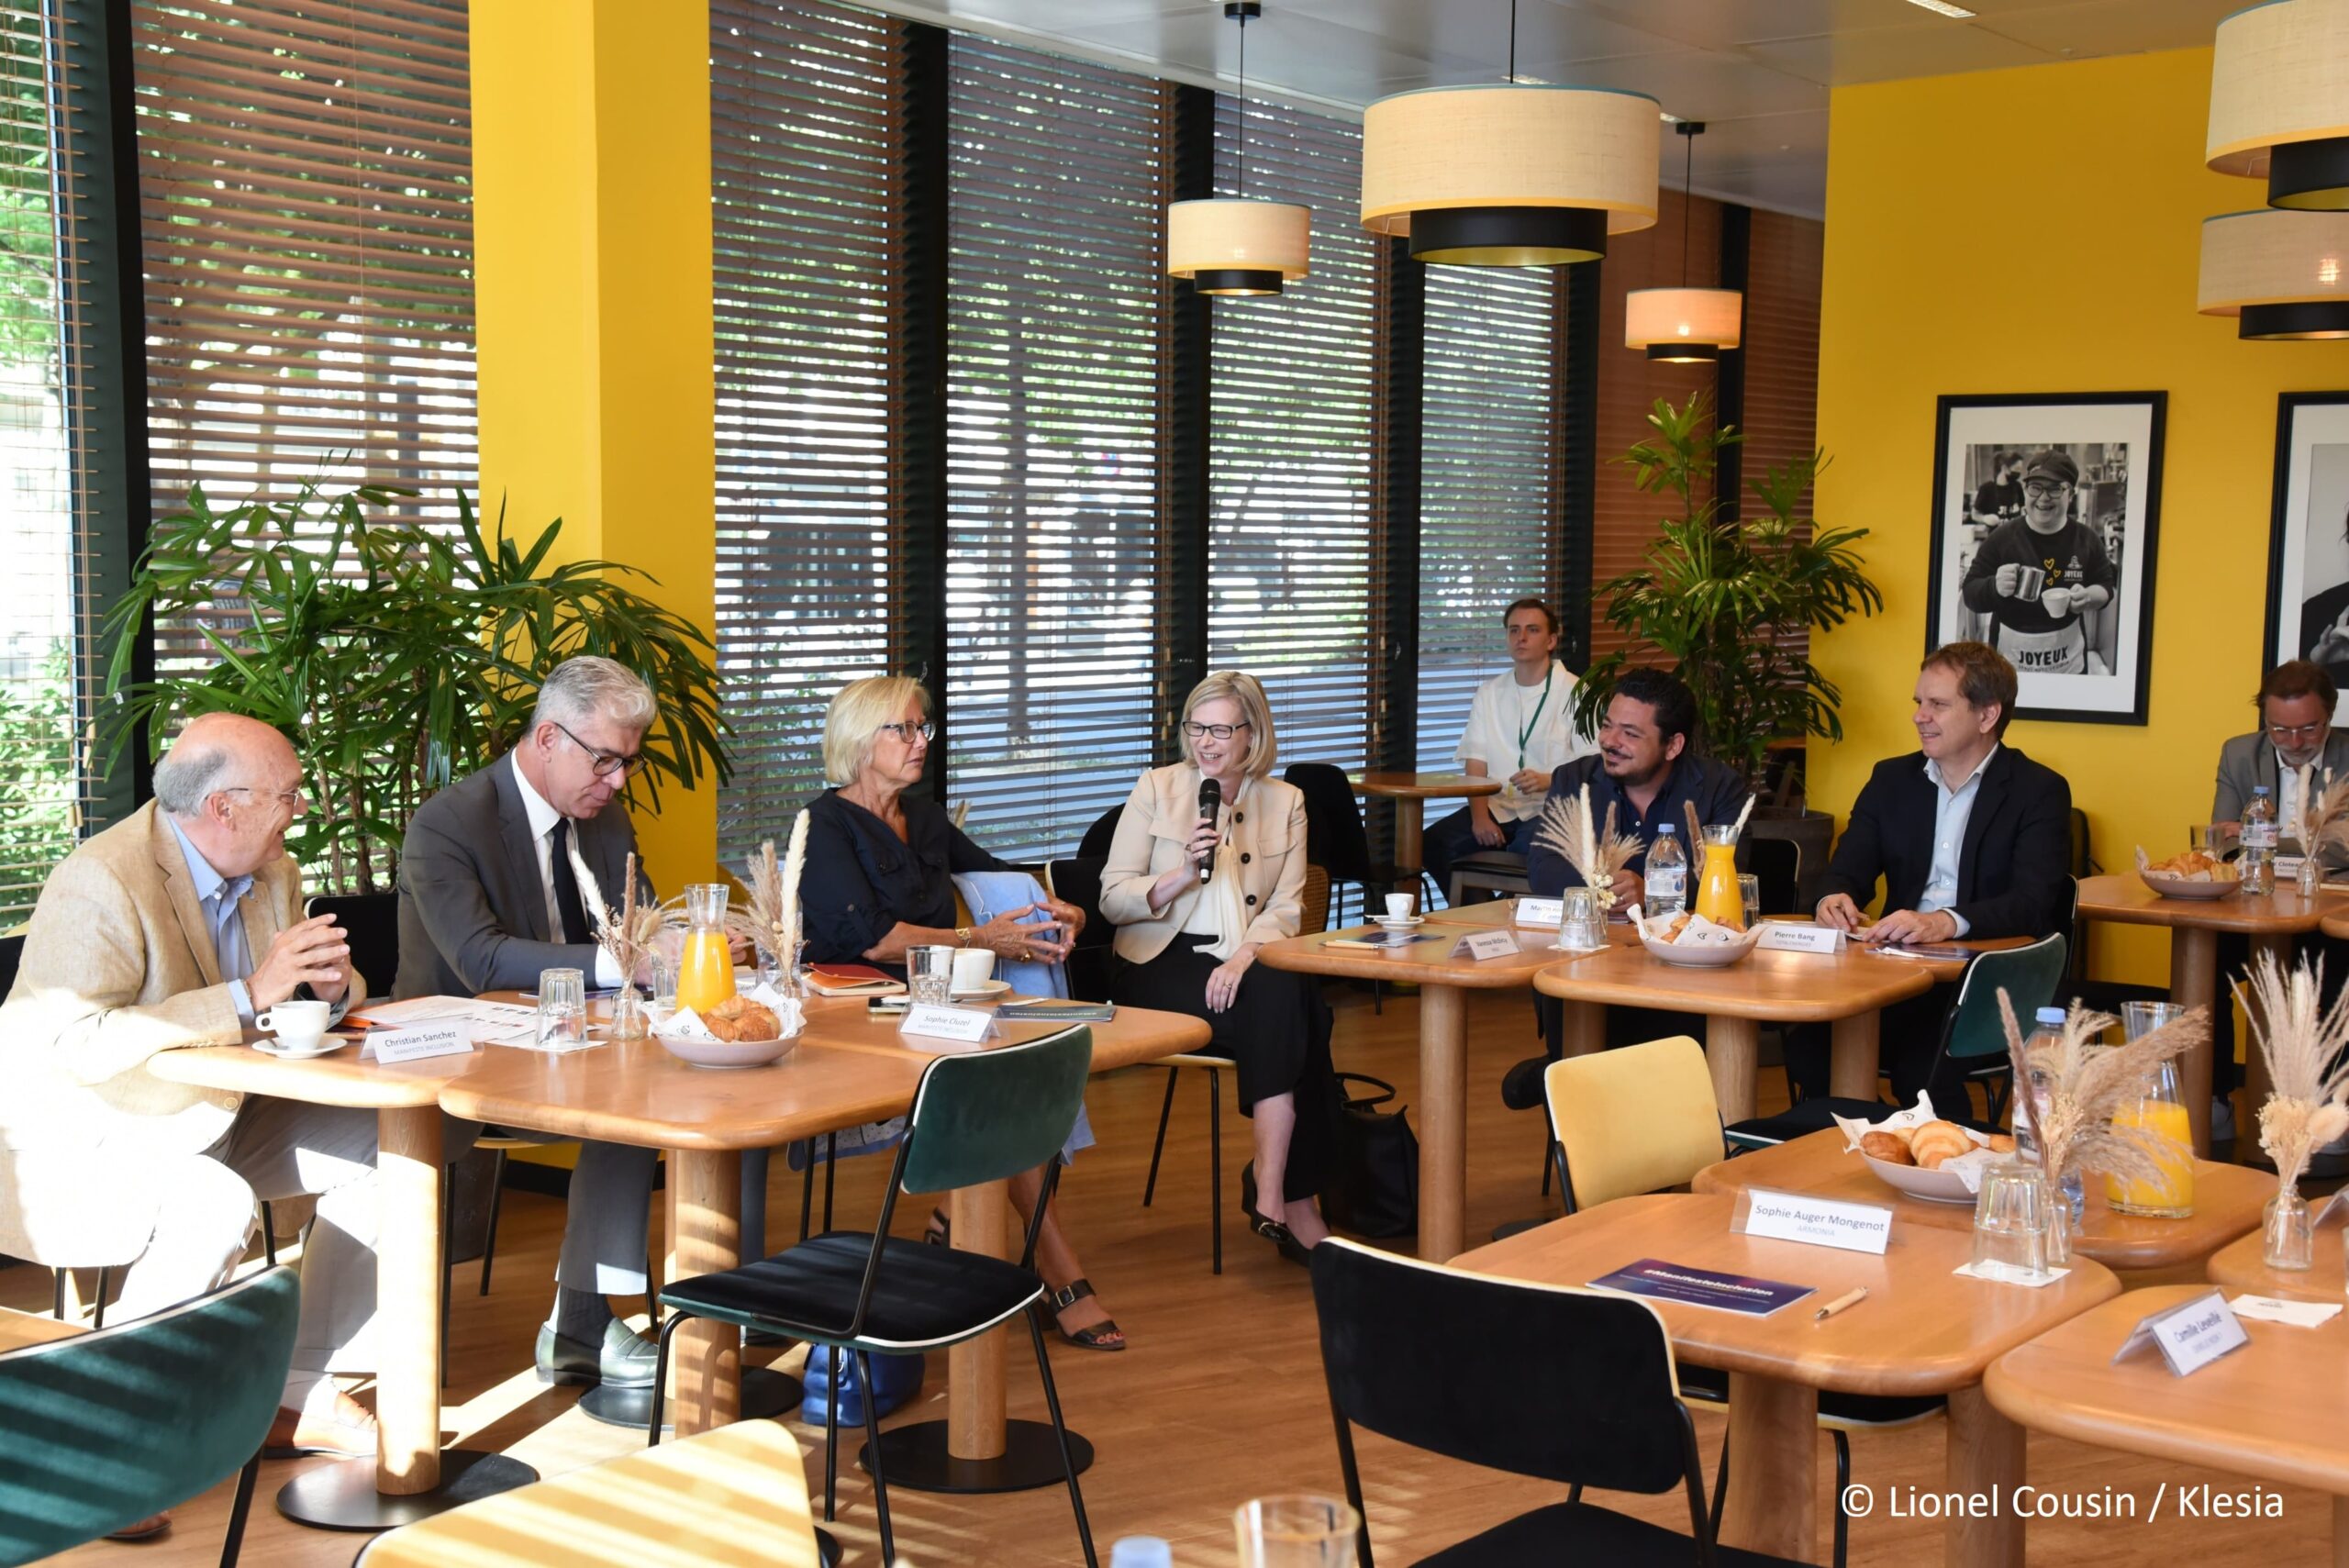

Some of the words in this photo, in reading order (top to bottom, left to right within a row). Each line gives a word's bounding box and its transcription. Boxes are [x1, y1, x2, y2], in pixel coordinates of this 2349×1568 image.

[2019, 645, 2068, 666] JOYEUX
[1798, 933, 1816, 941] Bang
[924, 1015, 948, 1024] Sophie
[949, 1018, 971, 1027] Cluzel
[384, 1037, 422, 1048] Christian
[423, 1031, 457, 1042] Sanchez
[1755, 1205, 1791, 1219] Sophie
[1794, 1210, 1825, 1224] Auger
[1828, 1216, 1885, 1231] Mongenot
[1796, 1226, 1836, 1237] ARMONIA
[2174, 1323, 2200, 1343] Camille
